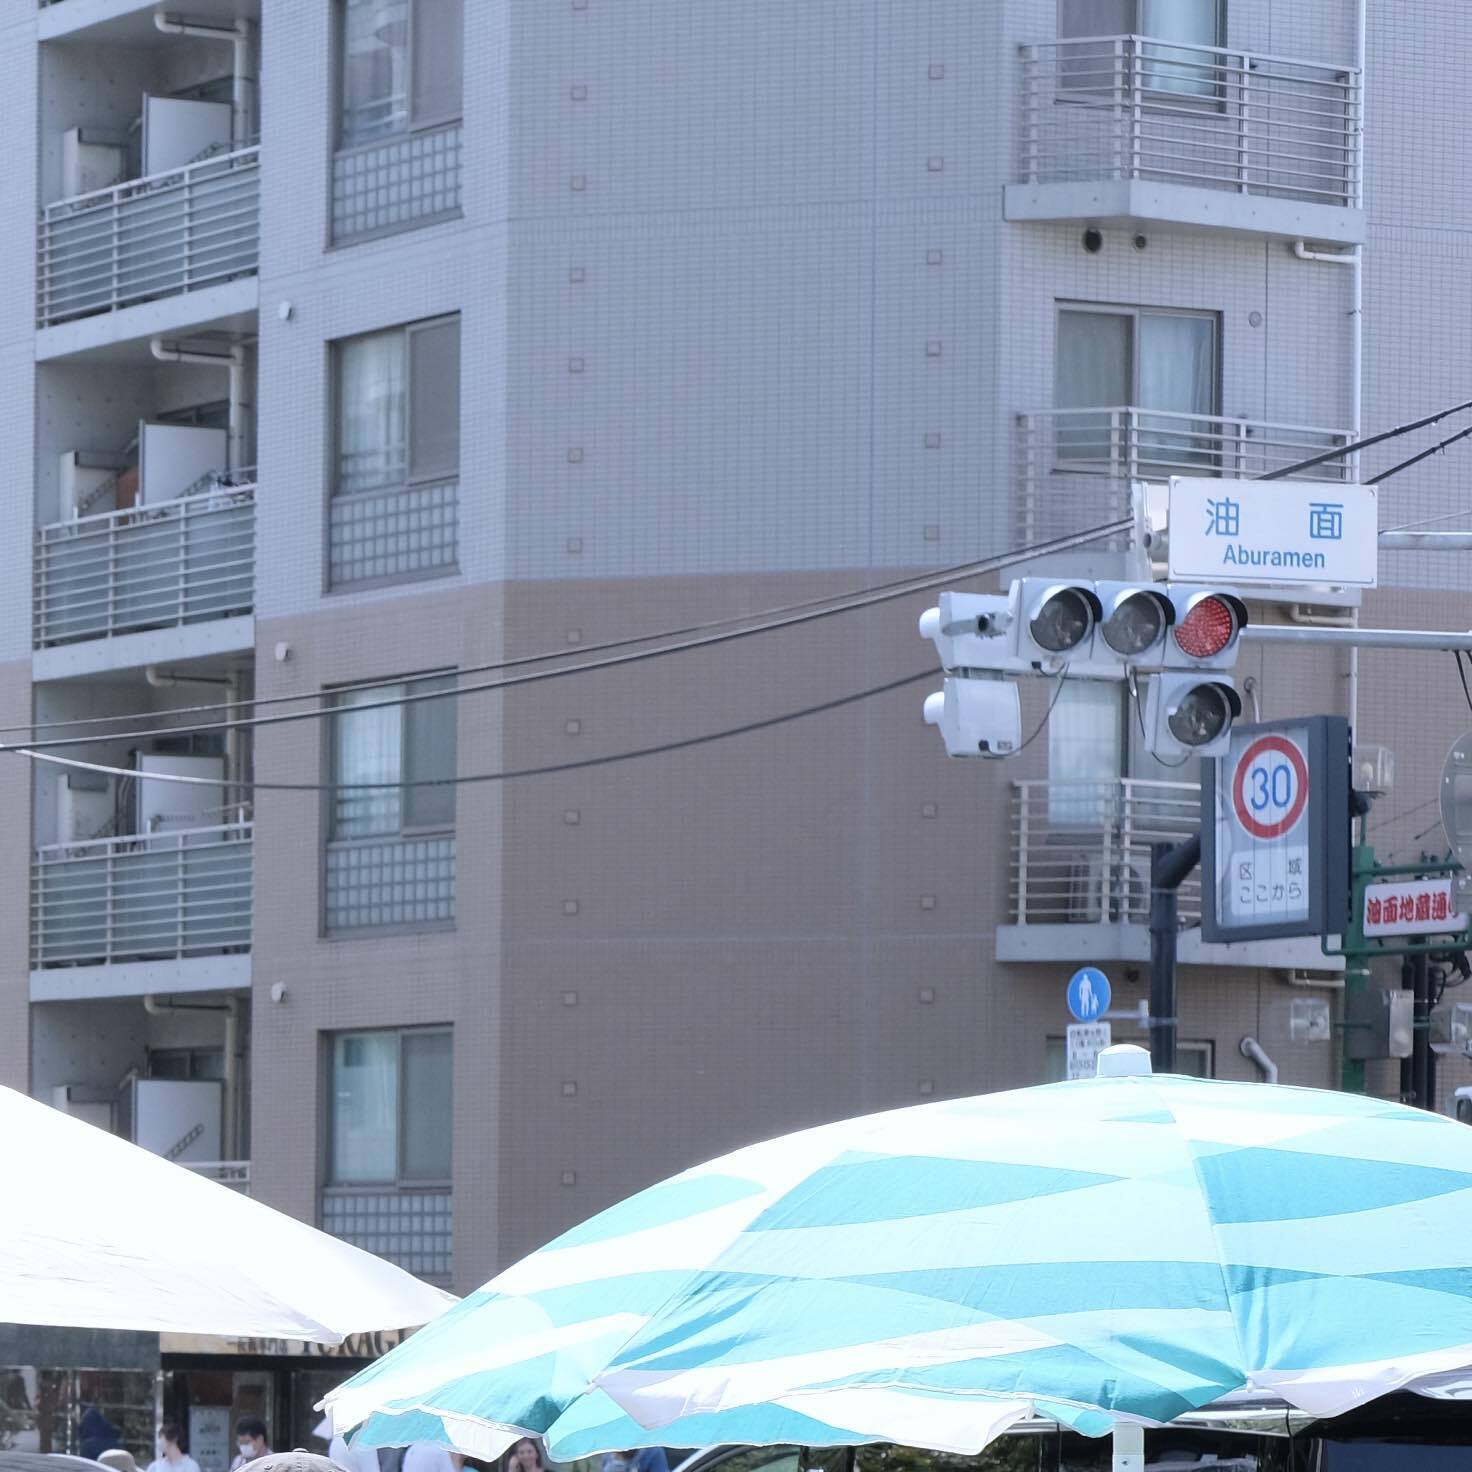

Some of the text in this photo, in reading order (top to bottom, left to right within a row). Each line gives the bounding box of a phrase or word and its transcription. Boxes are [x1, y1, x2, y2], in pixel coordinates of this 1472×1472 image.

[1206, 497, 1344, 540] 油面
[1223, 544, 1325, 568] Aburamen
[1251, 765, 1291, 810] 30
[1240, 884, 1302, 905] ここから
